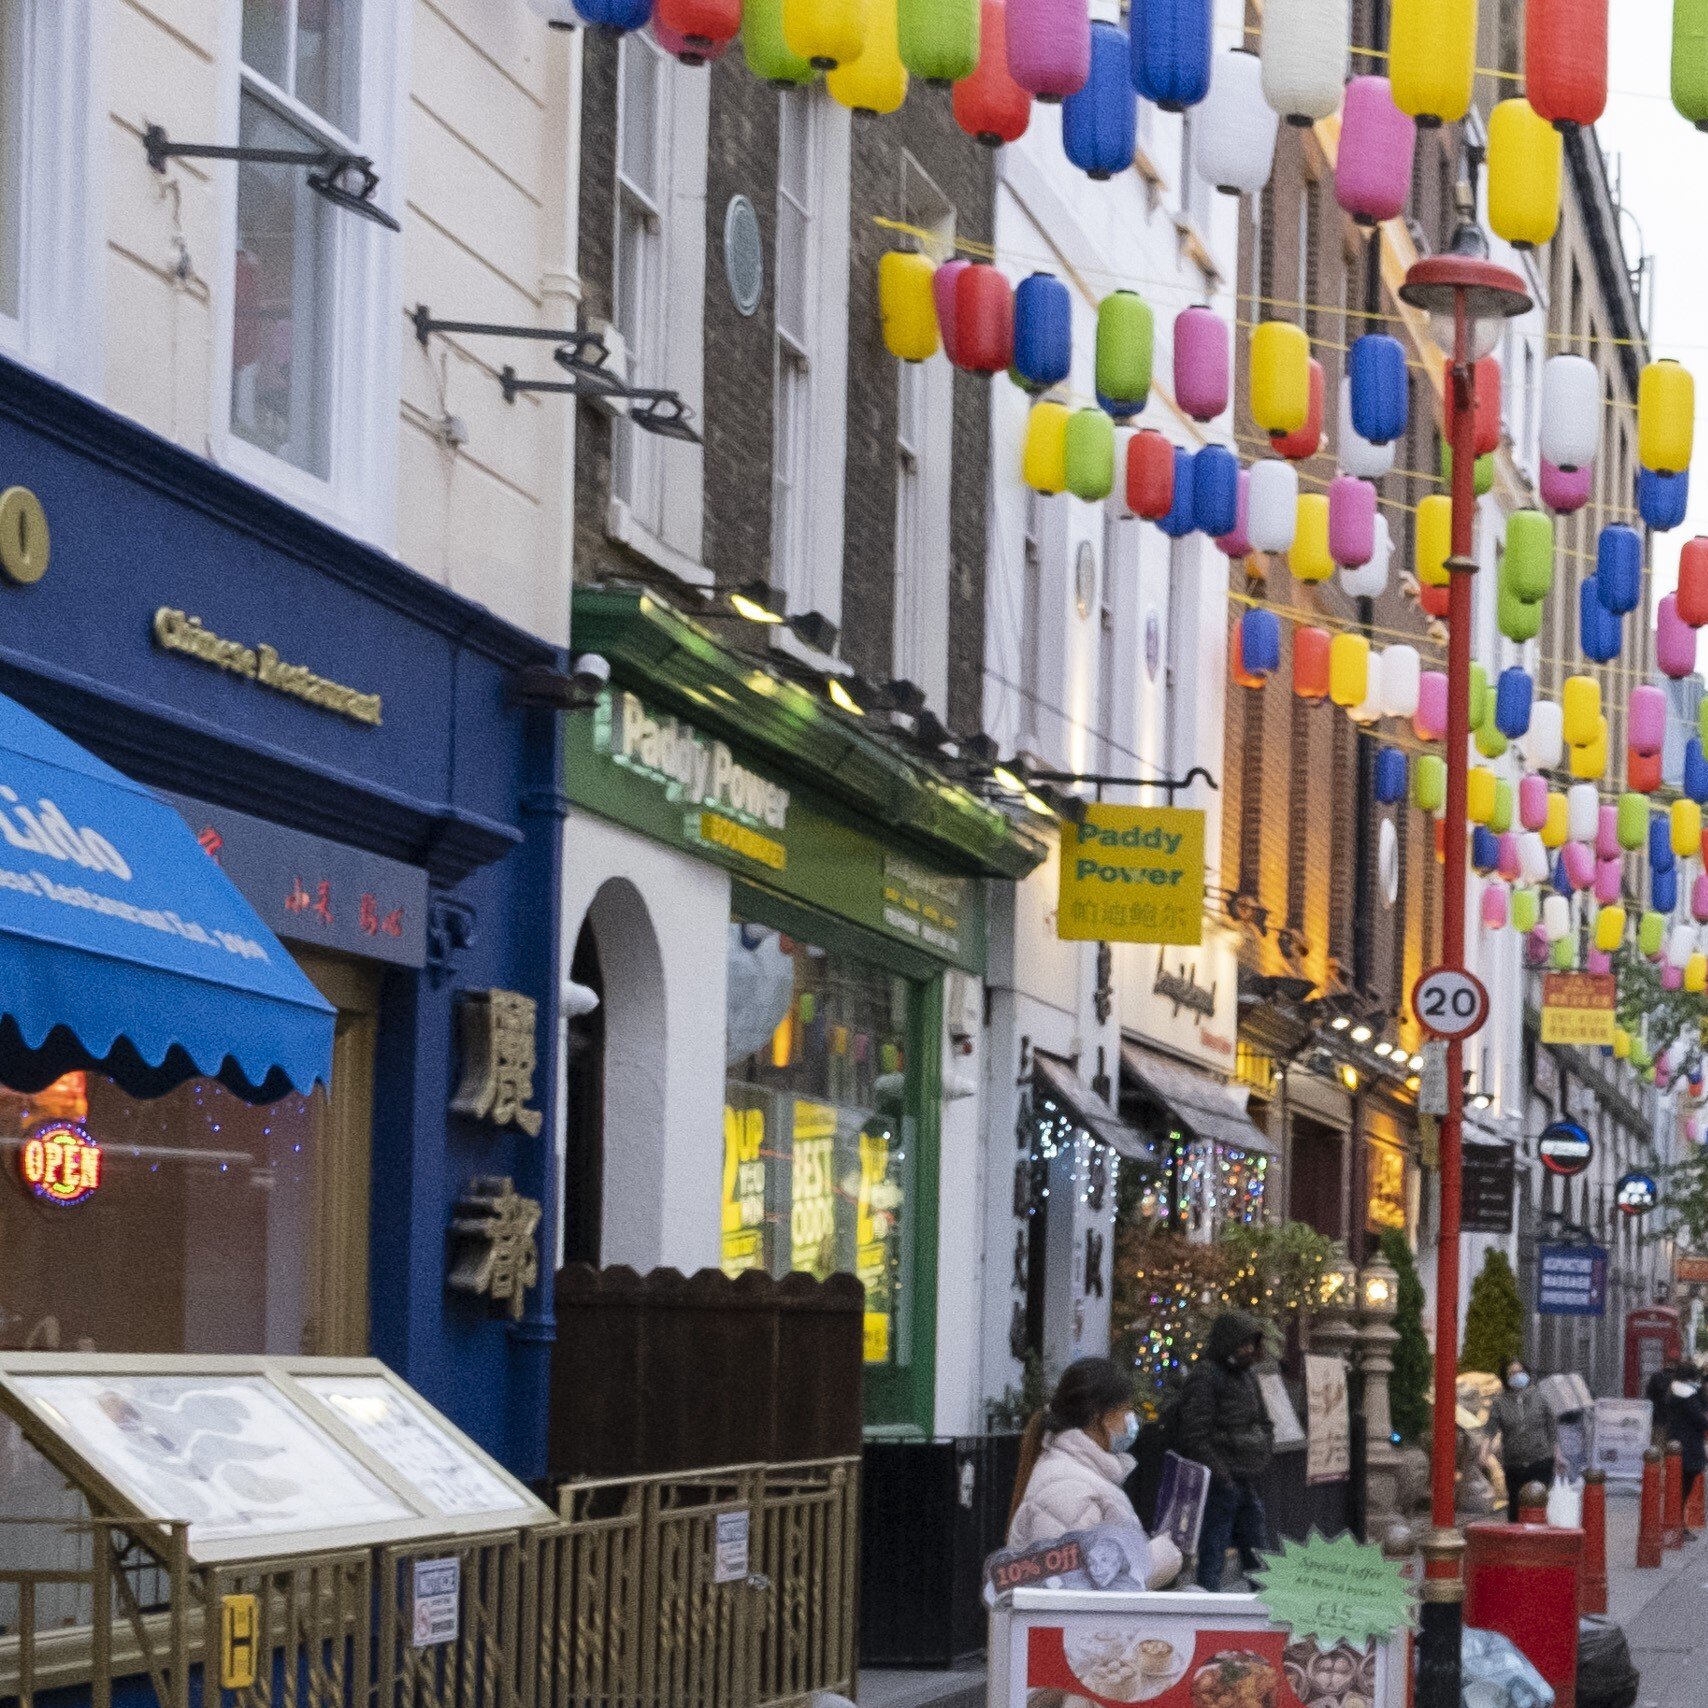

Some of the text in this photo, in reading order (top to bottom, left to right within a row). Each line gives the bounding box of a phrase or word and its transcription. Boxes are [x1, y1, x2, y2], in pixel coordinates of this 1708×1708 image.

[622, 690, 789, 829] Paddy Power
[1076, 823, 1182, 855] Paddy
[1076, 859, 1183, 886] Power
[1424, 986, 1476, 1017] 20
[25, 1140, 100, 1189] OPEN
[995, 1541, 1081, 1587] 10% Off
[1299, 1557, 1350, 1577] Special
